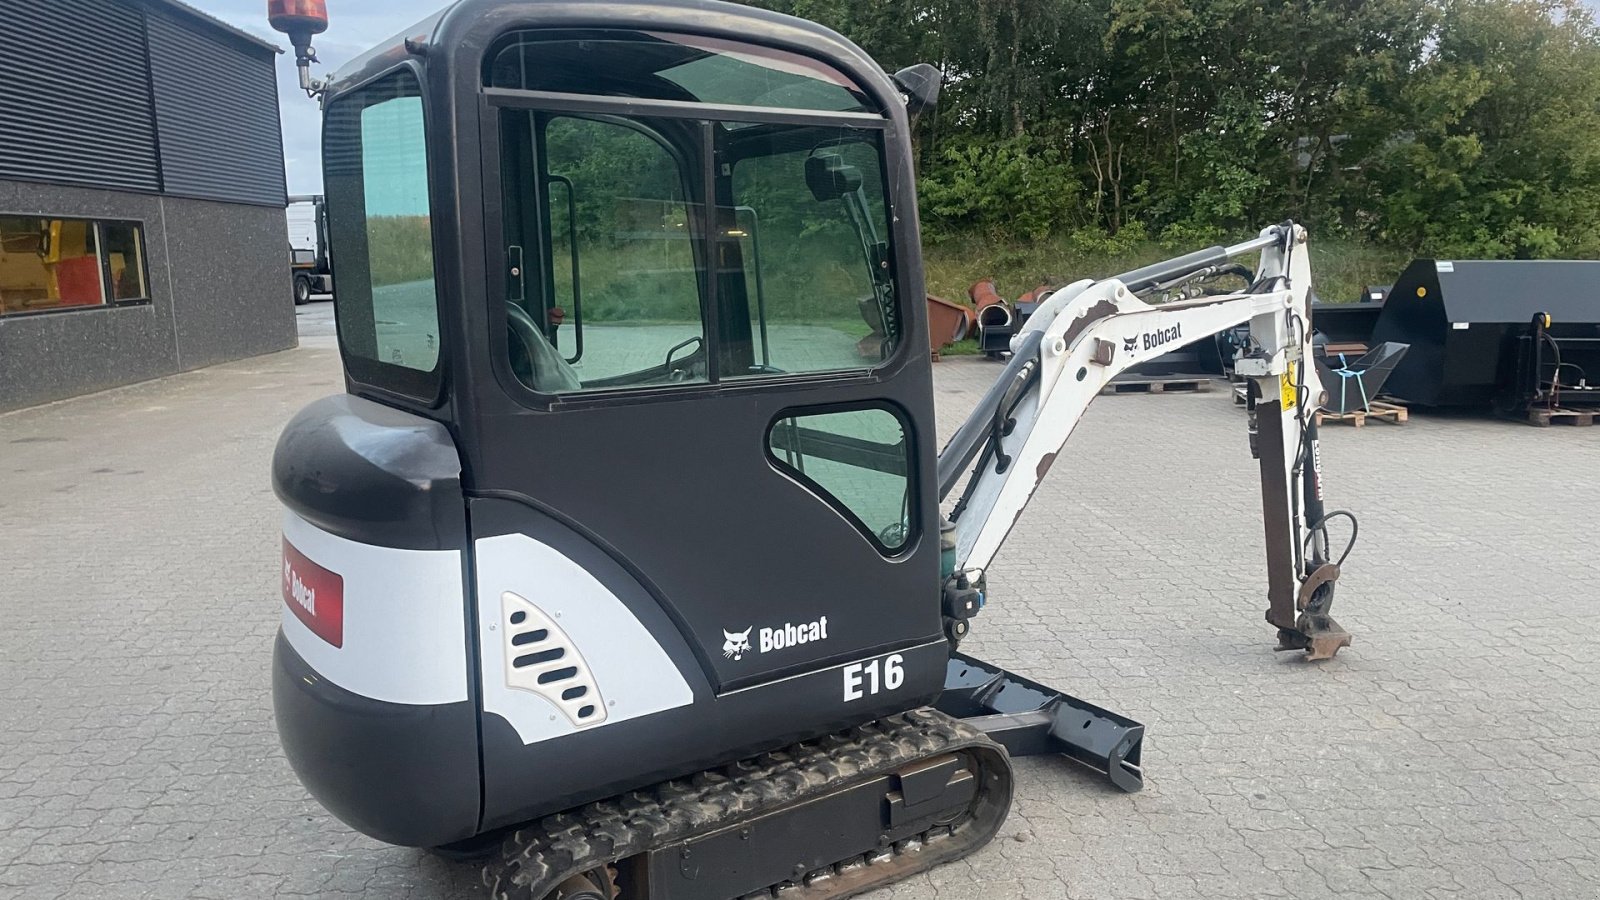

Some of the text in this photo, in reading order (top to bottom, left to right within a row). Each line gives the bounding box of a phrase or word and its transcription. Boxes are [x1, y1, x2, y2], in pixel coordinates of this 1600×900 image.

[1142, 322, 1182, 351] Bobcat
[291, 570, 316, 616] Bobcat
[759, 616, 828, 653] Bobcat
[844, 654, 904, 702] E16
